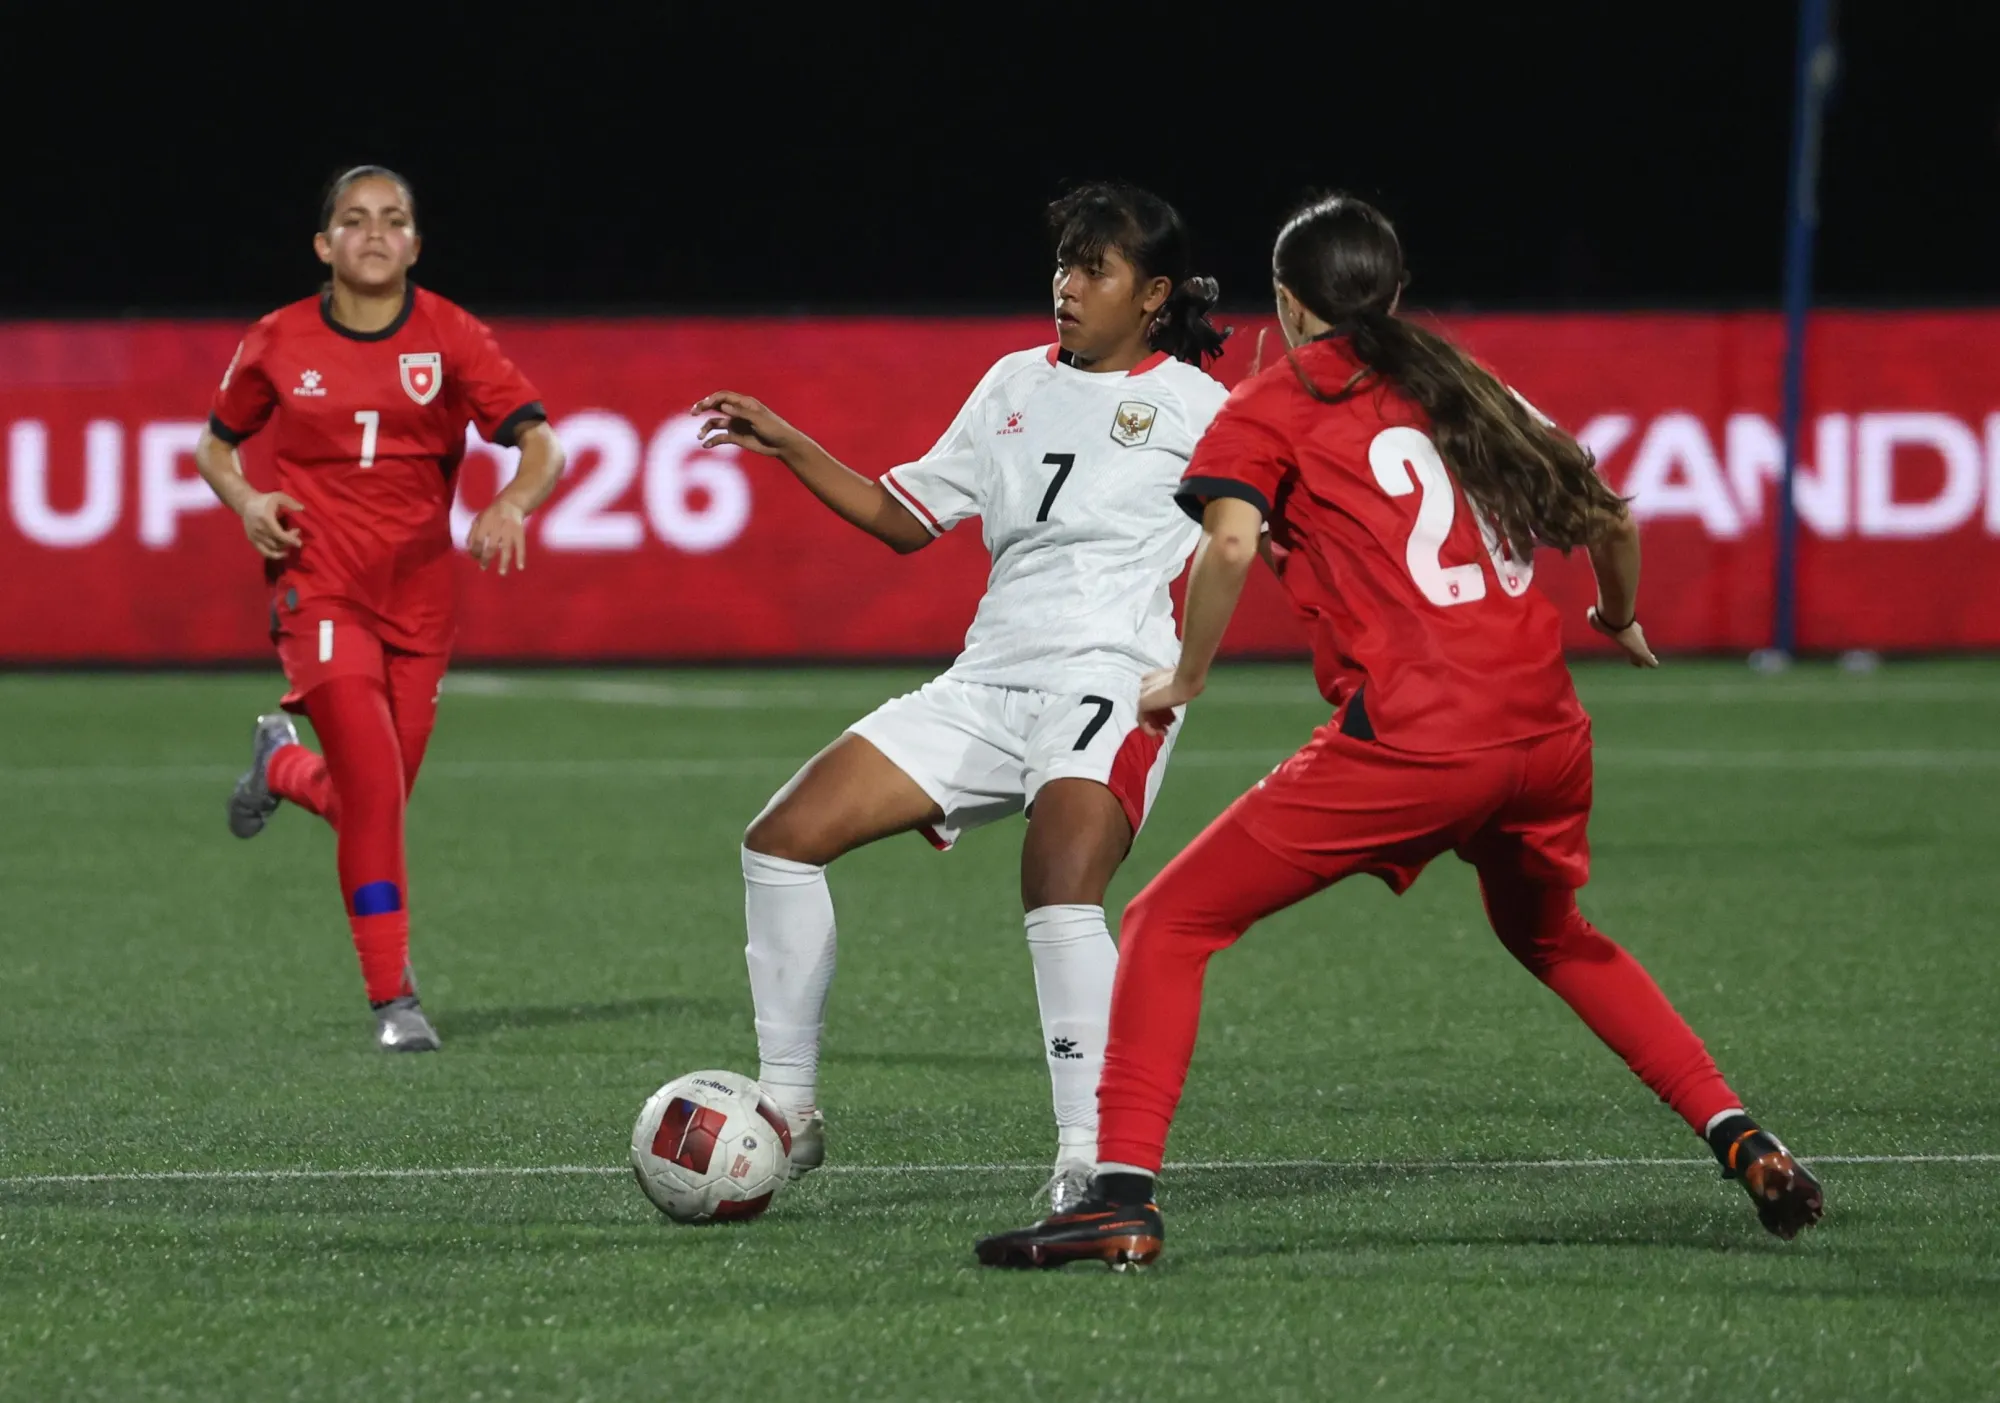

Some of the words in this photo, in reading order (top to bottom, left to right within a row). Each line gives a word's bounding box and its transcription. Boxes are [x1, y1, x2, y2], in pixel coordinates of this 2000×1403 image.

[354, 410, 380, 468] 1
[1036, 453, 1076, 522] 7
[1574, 411, 2000, 541] AND
[1071, 694, 1114, 751] 7
[691, 1078, 735, 1096] molten
